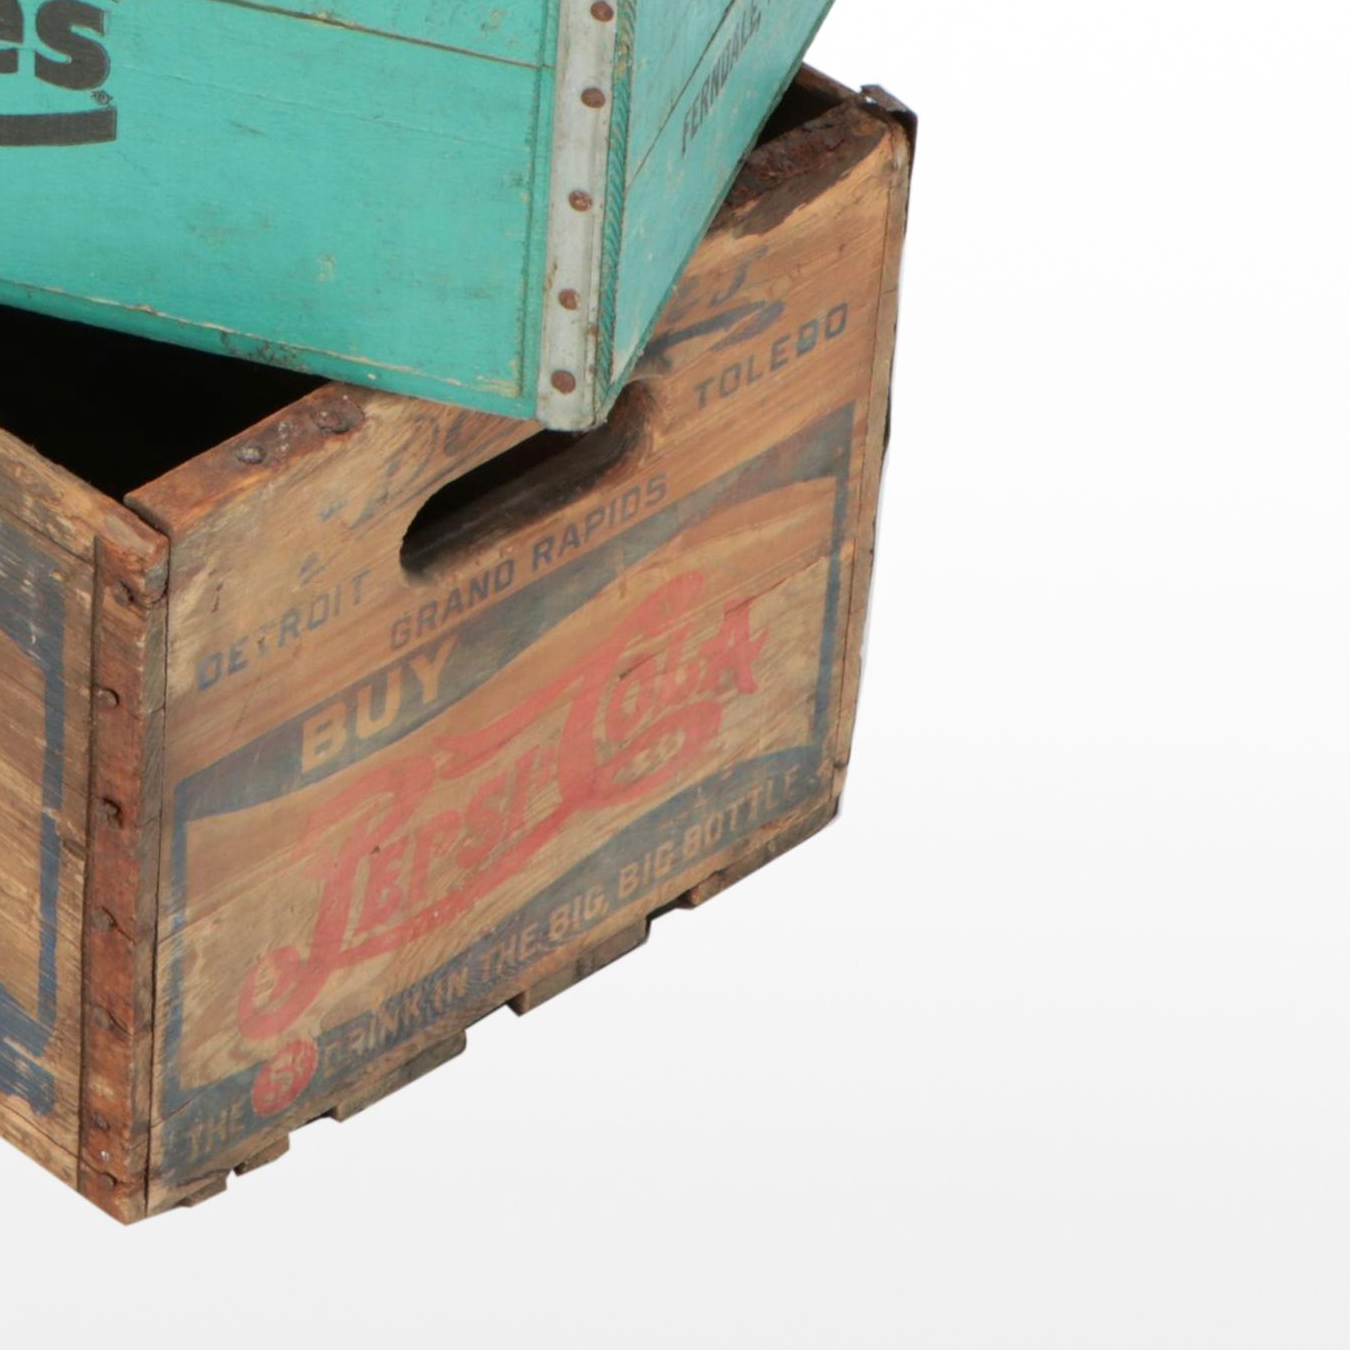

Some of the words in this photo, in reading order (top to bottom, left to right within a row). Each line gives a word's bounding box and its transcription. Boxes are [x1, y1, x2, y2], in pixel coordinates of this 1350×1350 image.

[198, 568, 371, 691] DETROIT
[390, 556, 516, 650] GRAND
[531, 472, 668, 569] RAPIDS
[693, 302, 849, 408] TOLEDO
[300, 636, 458, 775] BUY
[480, 921, 541, 985] THE
[617, 847, 677, 902] BIG
[682, 764, 802, 860] BOTTLE
